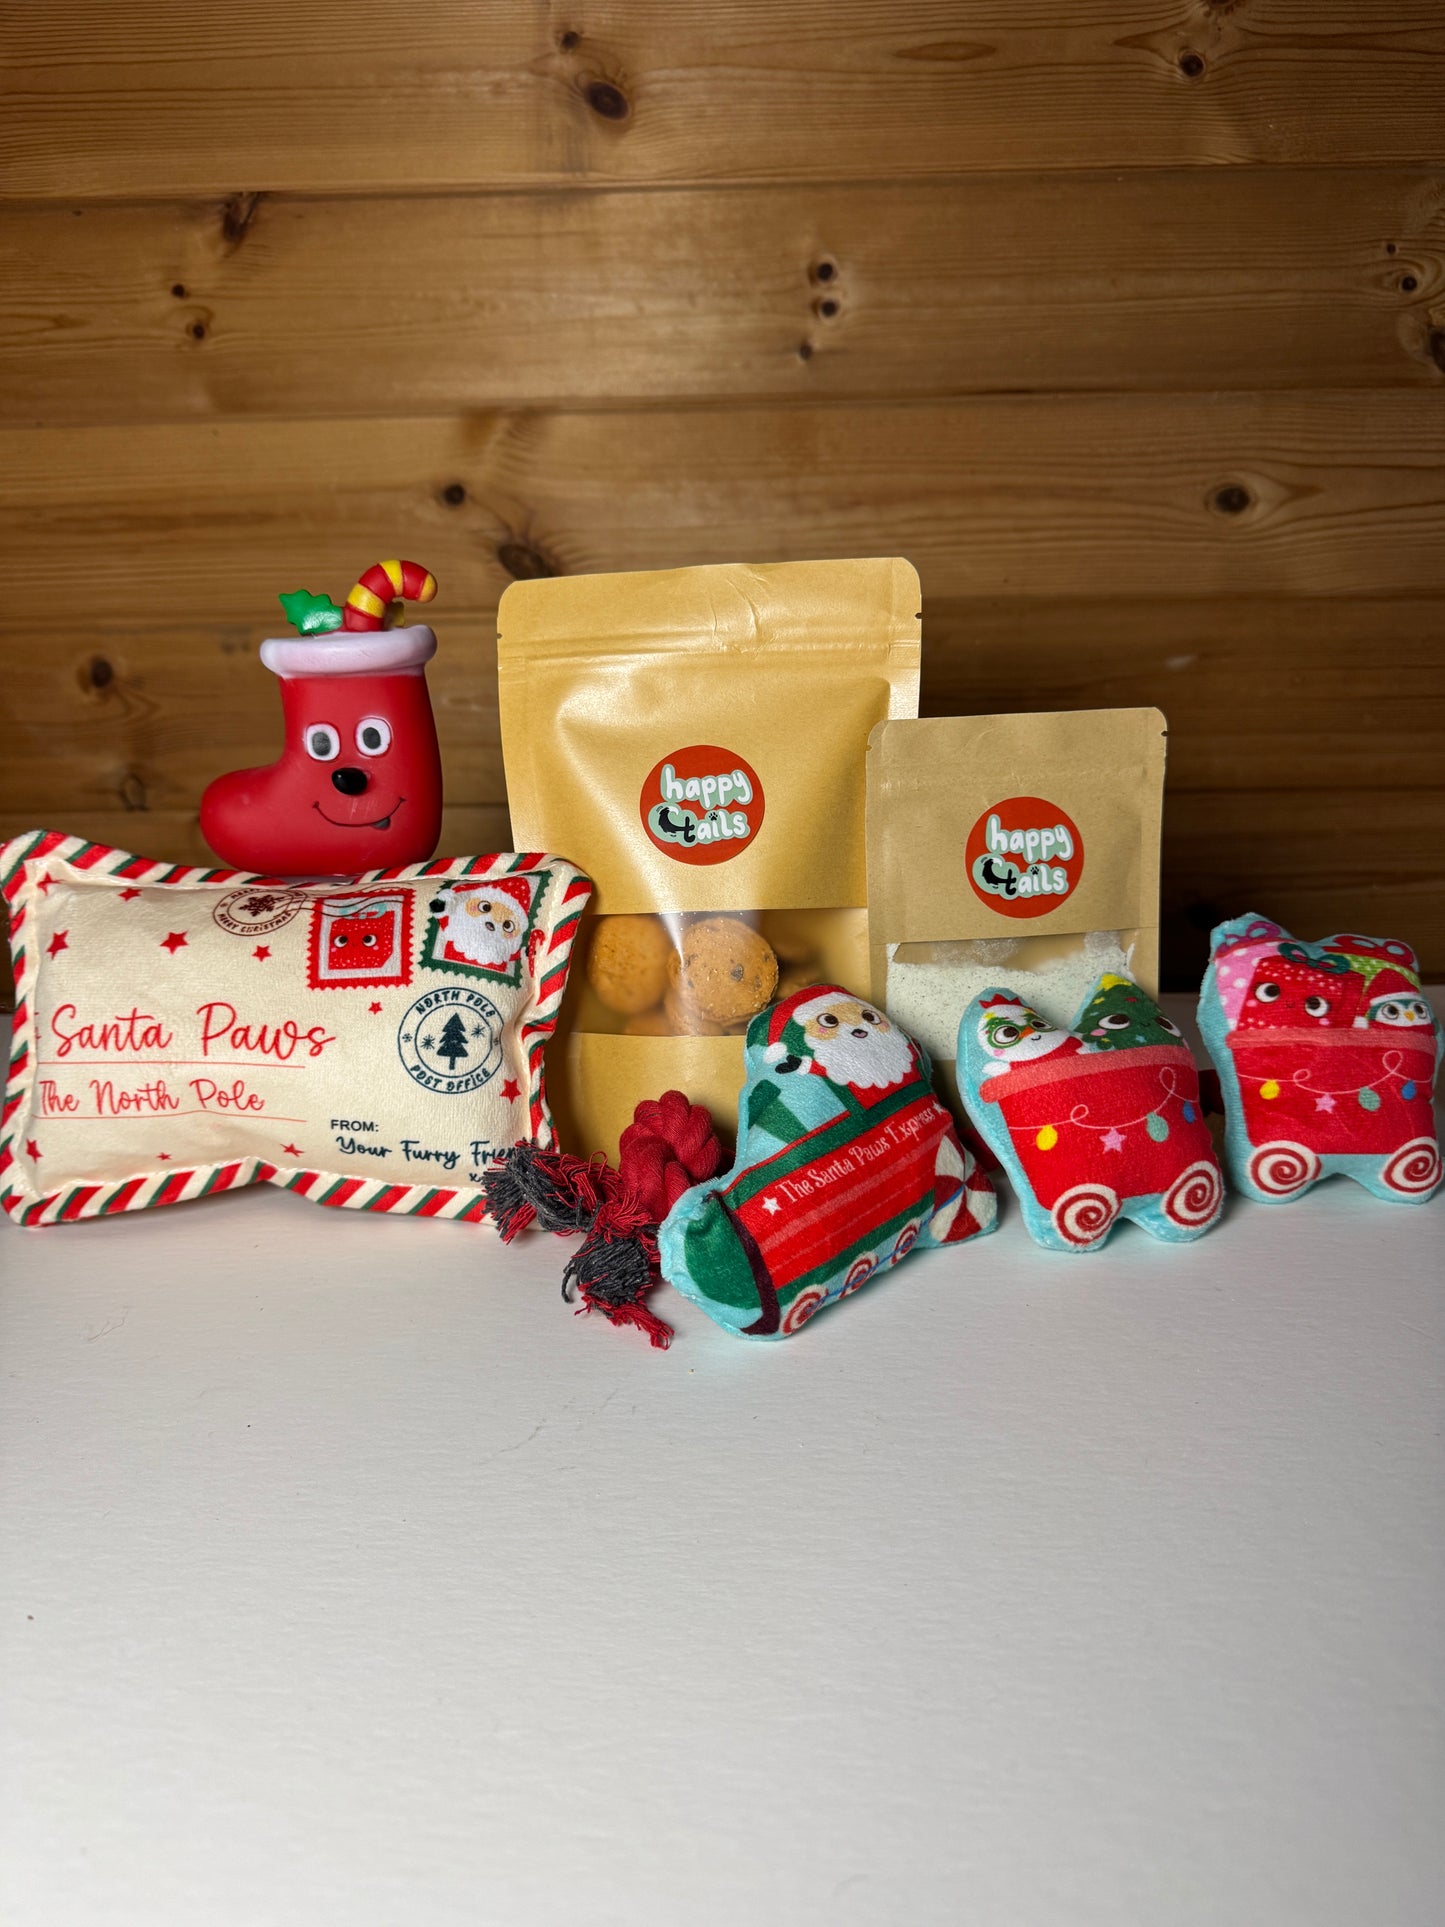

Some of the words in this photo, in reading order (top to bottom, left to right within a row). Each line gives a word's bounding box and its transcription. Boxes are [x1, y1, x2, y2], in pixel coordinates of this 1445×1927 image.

[663, 766, 752, 809] happy
[658, 805, 748, 843] tails
[988, 816, 1073, 862] happy
[982, 857, 1066, 895] tails
[415, 990, 460, 1015] NORTH
[466, 993, 496, 1017] POLE
[51, 1003, 173, 1058] Santa
[196, 1001, 336, 1060] Paws
[410, 1064, 442, 1088] POST
[38, 1079, 80, 1116] The
[89, 1079, 180, 1115] North
[189, 1078, 265, 1111] Pole
[330, 1119, 380, 1132] FROM:
[335, 1136, 393, 1158] Your
[400, 1140, 461, 1170] Furry
[775, 1179, 815, 1204] The
[807, 1157, 856, 1188] Santa
[848, 1138, 892, 1166] Paws
[883, 1107, 936, 1144] Express
